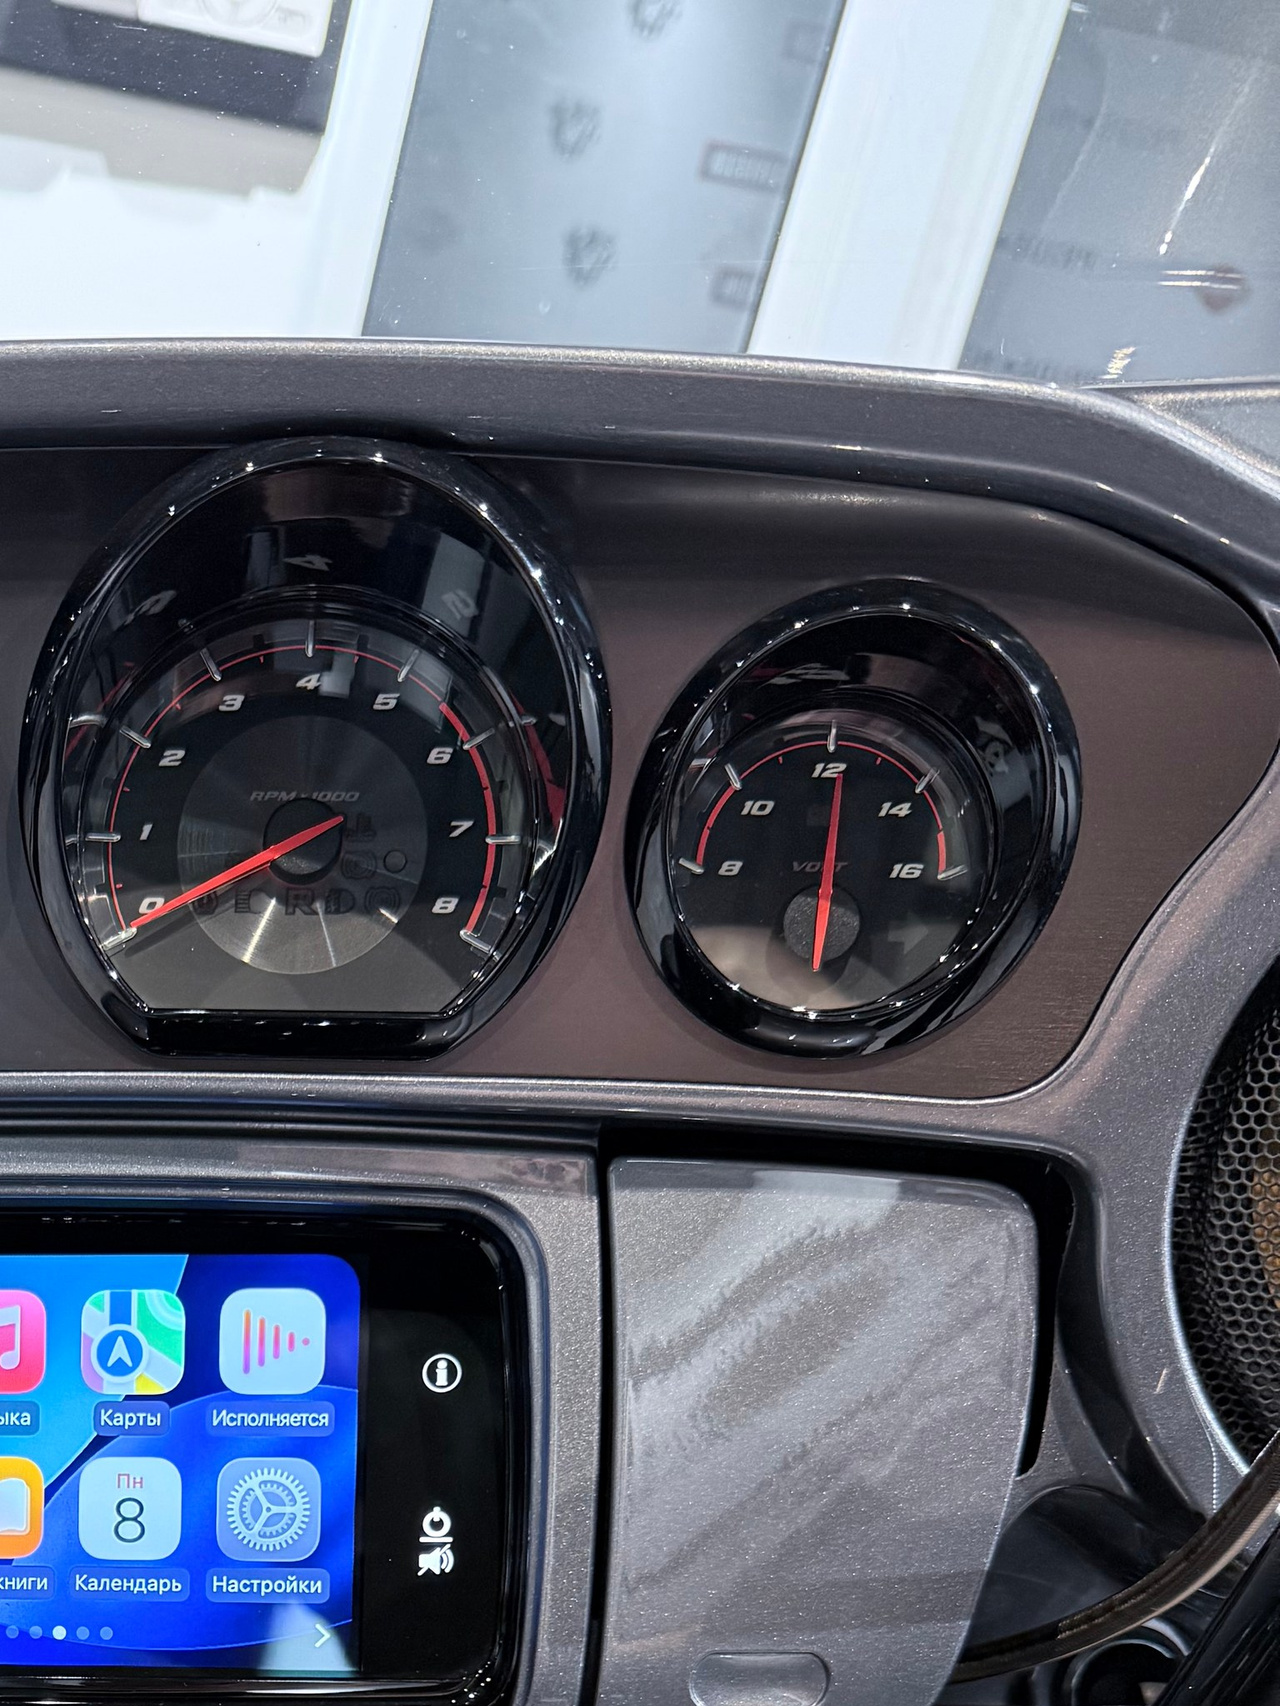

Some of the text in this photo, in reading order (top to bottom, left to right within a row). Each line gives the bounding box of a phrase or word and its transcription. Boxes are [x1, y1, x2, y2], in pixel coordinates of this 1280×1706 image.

[295, 674, 321, 690] 4
[218, 694, 245, 711] 3
[372, 693, 400, 710] 5
[158, 750, 186, 767] 2
[426, 747, 454, 764] 6
[811, 763, 848, 779] 12
[249, 791, 297, 802] RPM
[312, 791, 361, 802] 1000
[740, 800, 775, 816] 10
[878, 802, 913, 817] 14
[138, 823, 154, 841] 1
[449, 821, 474, 837] 7
[718, 861, 743, 876] 8
[792, 861, 848, 872] VOT
[889, 863, 924, 879] 16
[138, 897, 165, 915] 0
[431, 897, 459, 914] 8
[100, 1409, 161, 1430] Карты
[212, 1409, 329, 1428] Исполняется
[116, 1473, 144, 1489] Пн
[113, 1496, 146, 1544] 8
[75, 1574, 182, 1594] Календарь
[212, 1574, 322, 1595] Настройки
